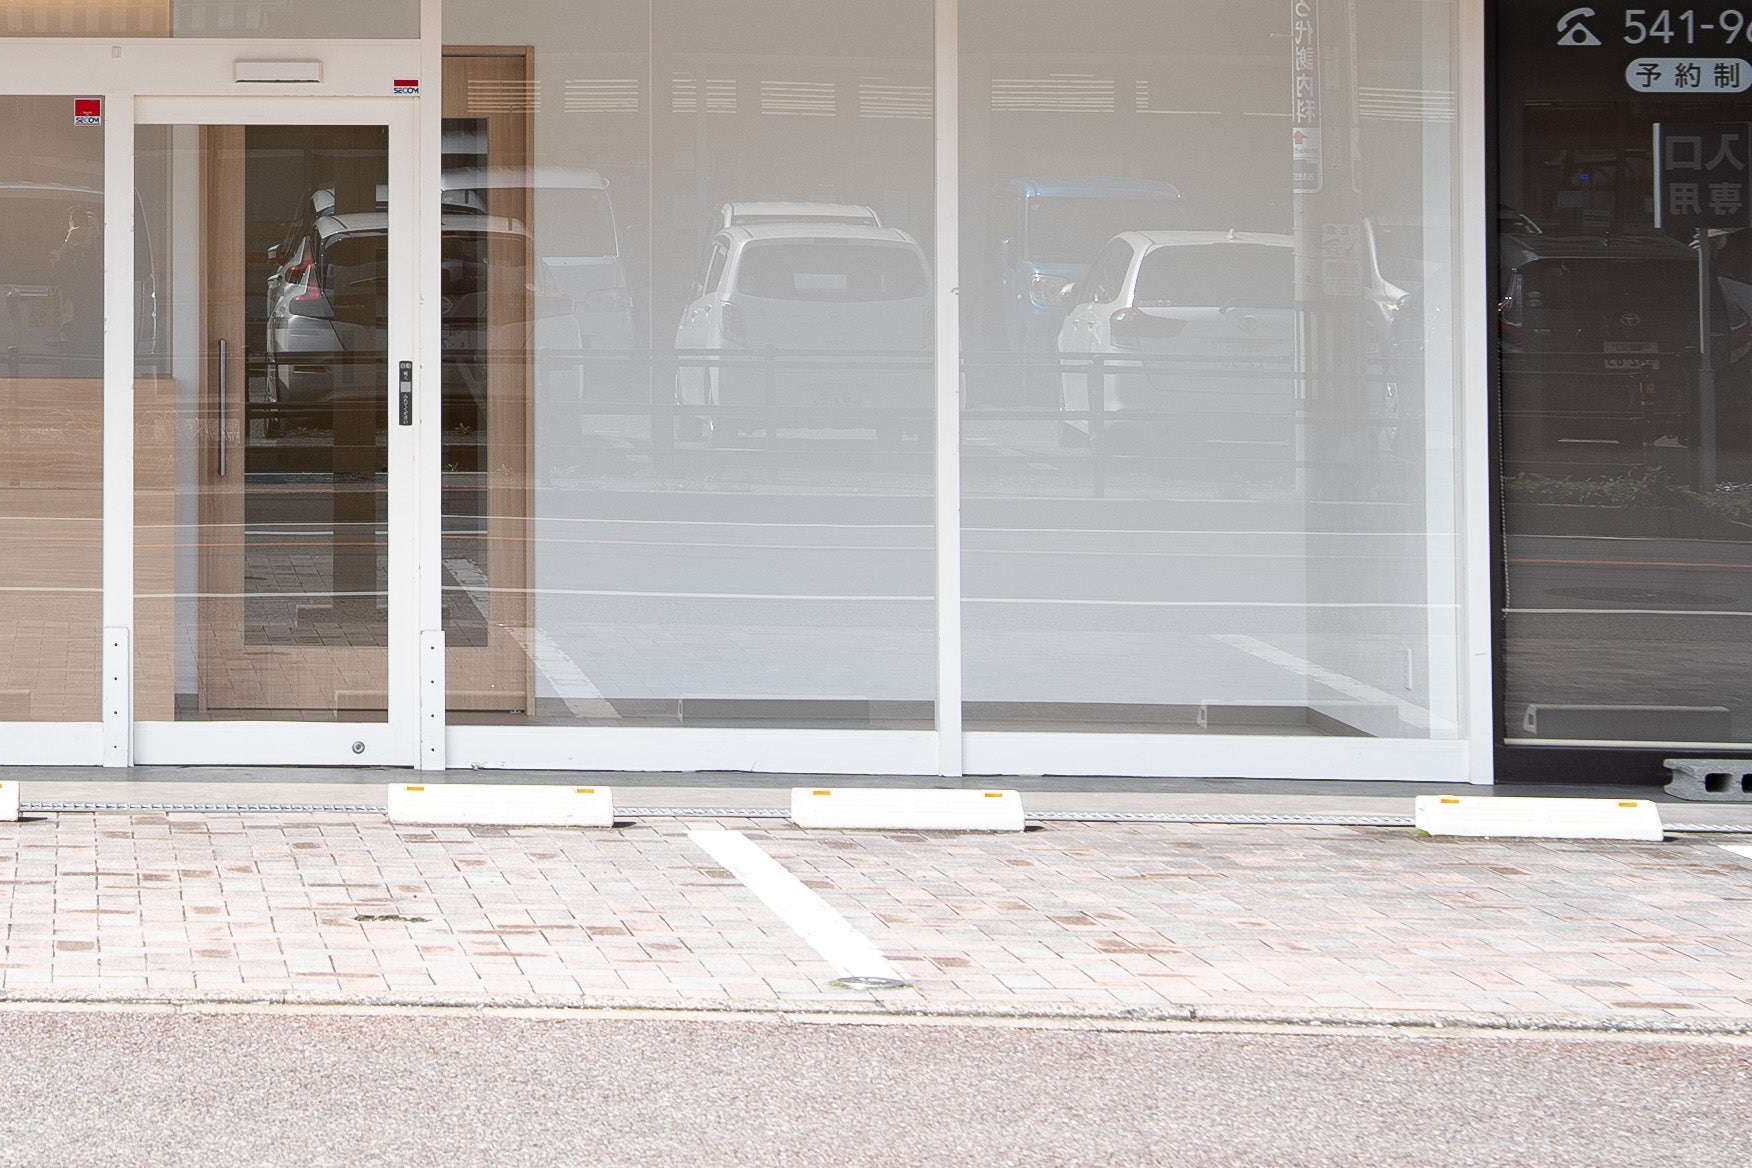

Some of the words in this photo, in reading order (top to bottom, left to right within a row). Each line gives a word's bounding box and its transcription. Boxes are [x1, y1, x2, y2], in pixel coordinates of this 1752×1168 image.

[1623, 9, 1752, 44] 541-9
[1635, 62, 1740, 89] 予約制
